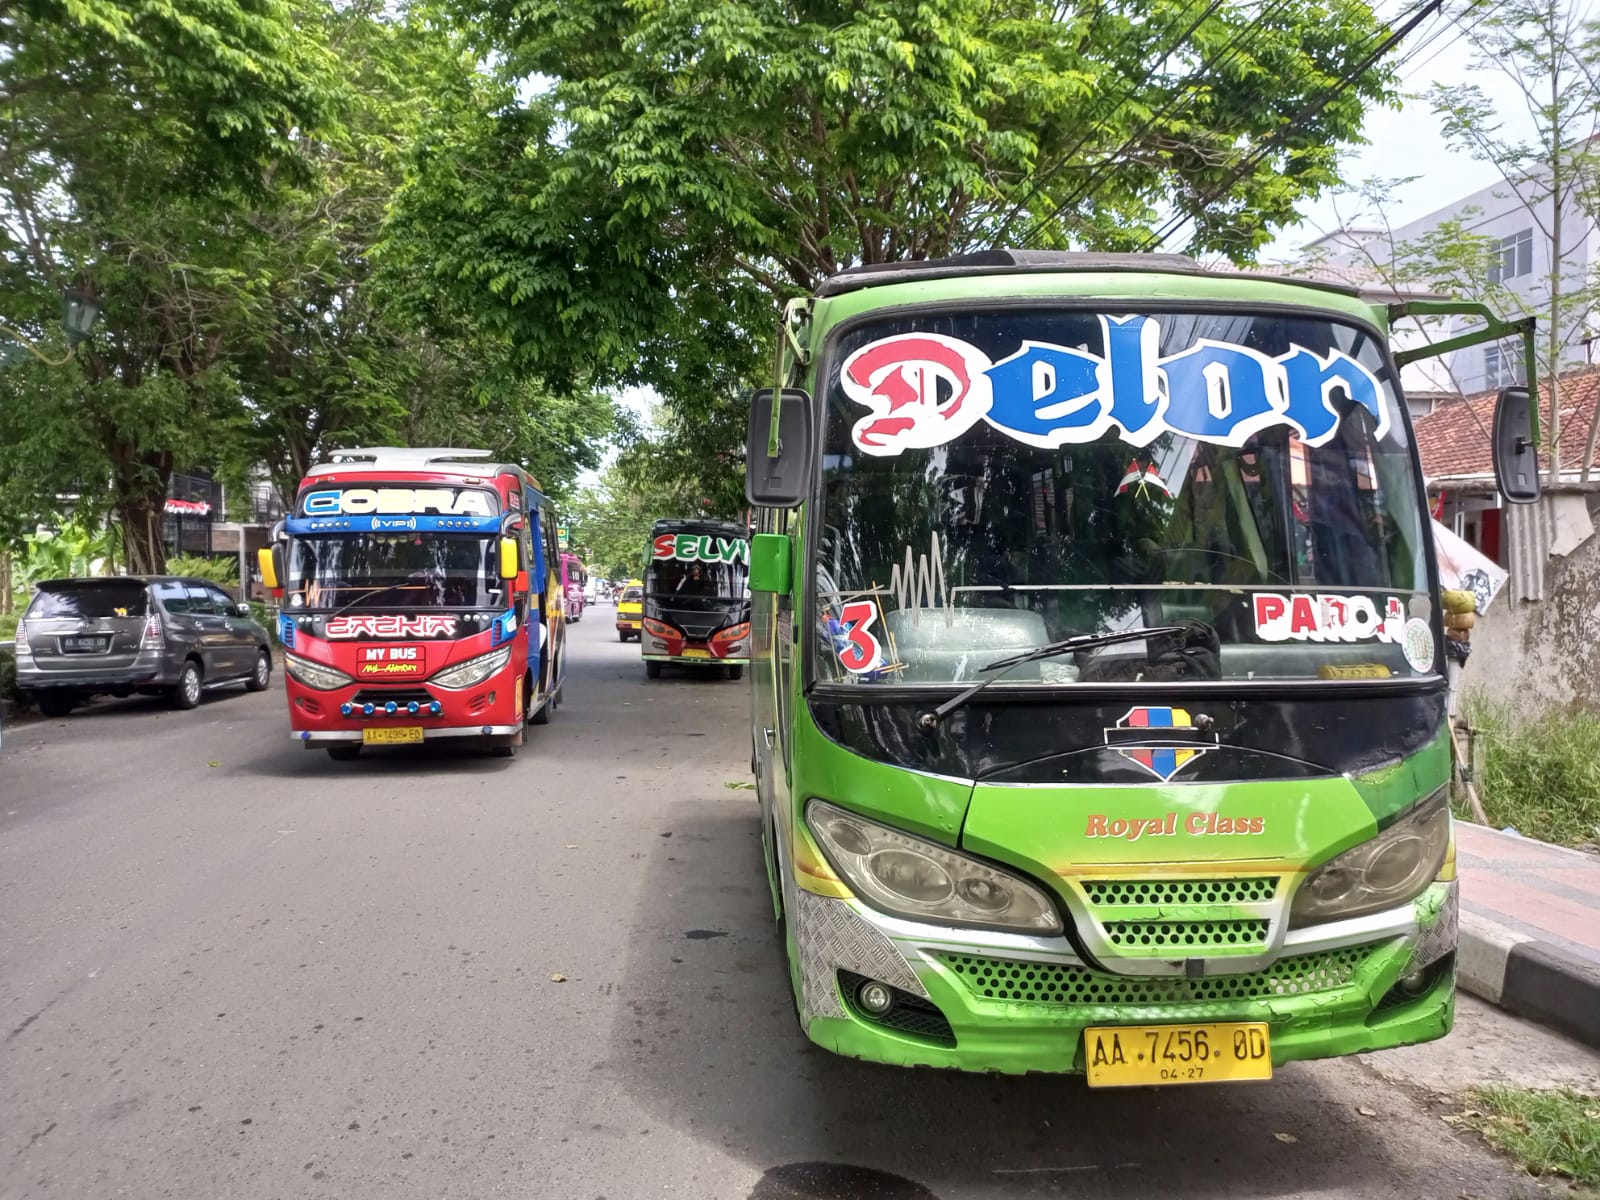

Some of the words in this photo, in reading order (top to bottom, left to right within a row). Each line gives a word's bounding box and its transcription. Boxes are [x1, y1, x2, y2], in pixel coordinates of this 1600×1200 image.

[304, 489, 488, 515] COBRA
[839, 600, 882, 674] 3
[366, 648, 385, 660] MY
[389, 648, 417, 660] BUS
[1085, 813, 1176, 841] Royal
[1185, 812, 1266, 835] Class
[1093, 1033, 1127, 1067] AA
[1146, 1029, 1210, 1064] 7456
